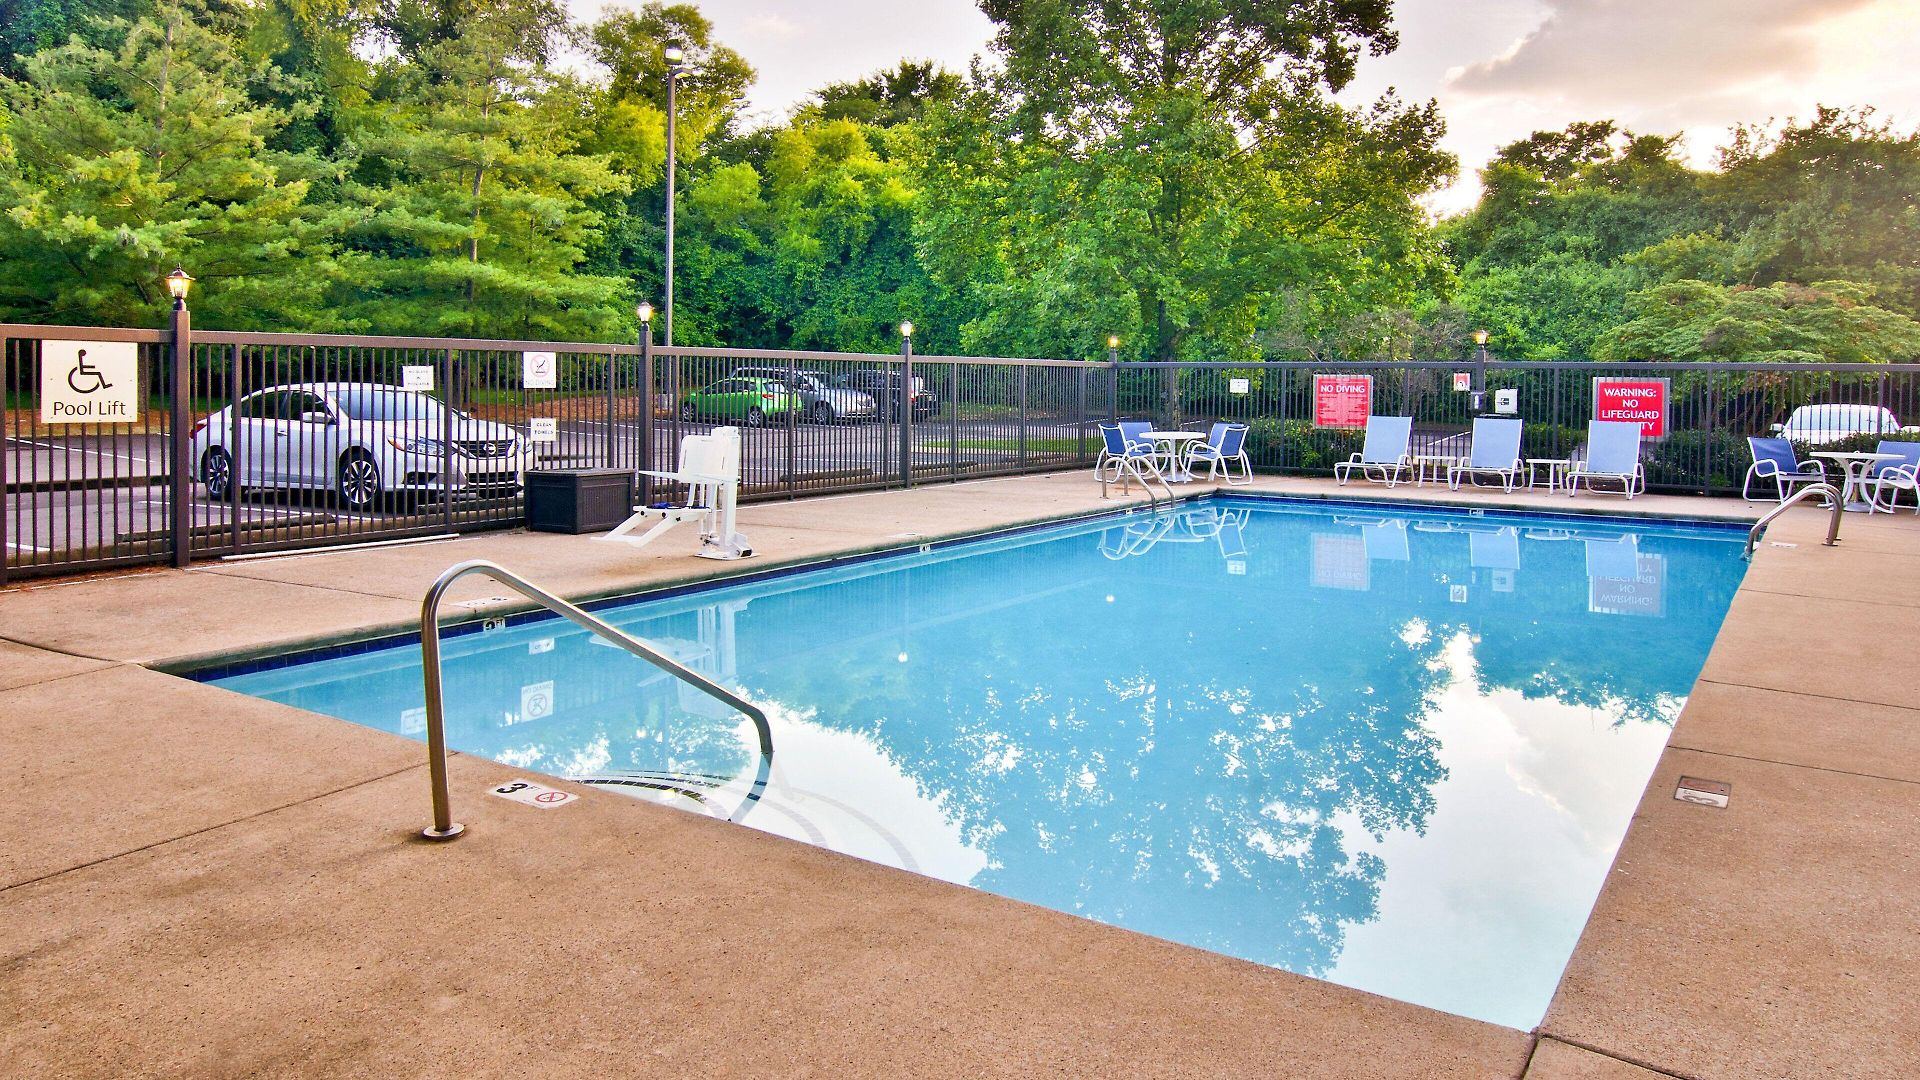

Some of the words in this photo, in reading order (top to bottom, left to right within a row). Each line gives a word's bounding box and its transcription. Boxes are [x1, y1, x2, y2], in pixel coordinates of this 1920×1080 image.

[1320, 384, 1334, 393] NO
[1336, 384, 1365, 393] DIVING
[1604, 388, 1657, 397] WARNING:
[53, 401, 92, 415] Pool
[98, 401, 126, 415] Lift
[1622, 399, 1639, 408] NO
[1602, 410, 1659, 419] LIFEGUARD
[496, 783, 528, 793] 3
